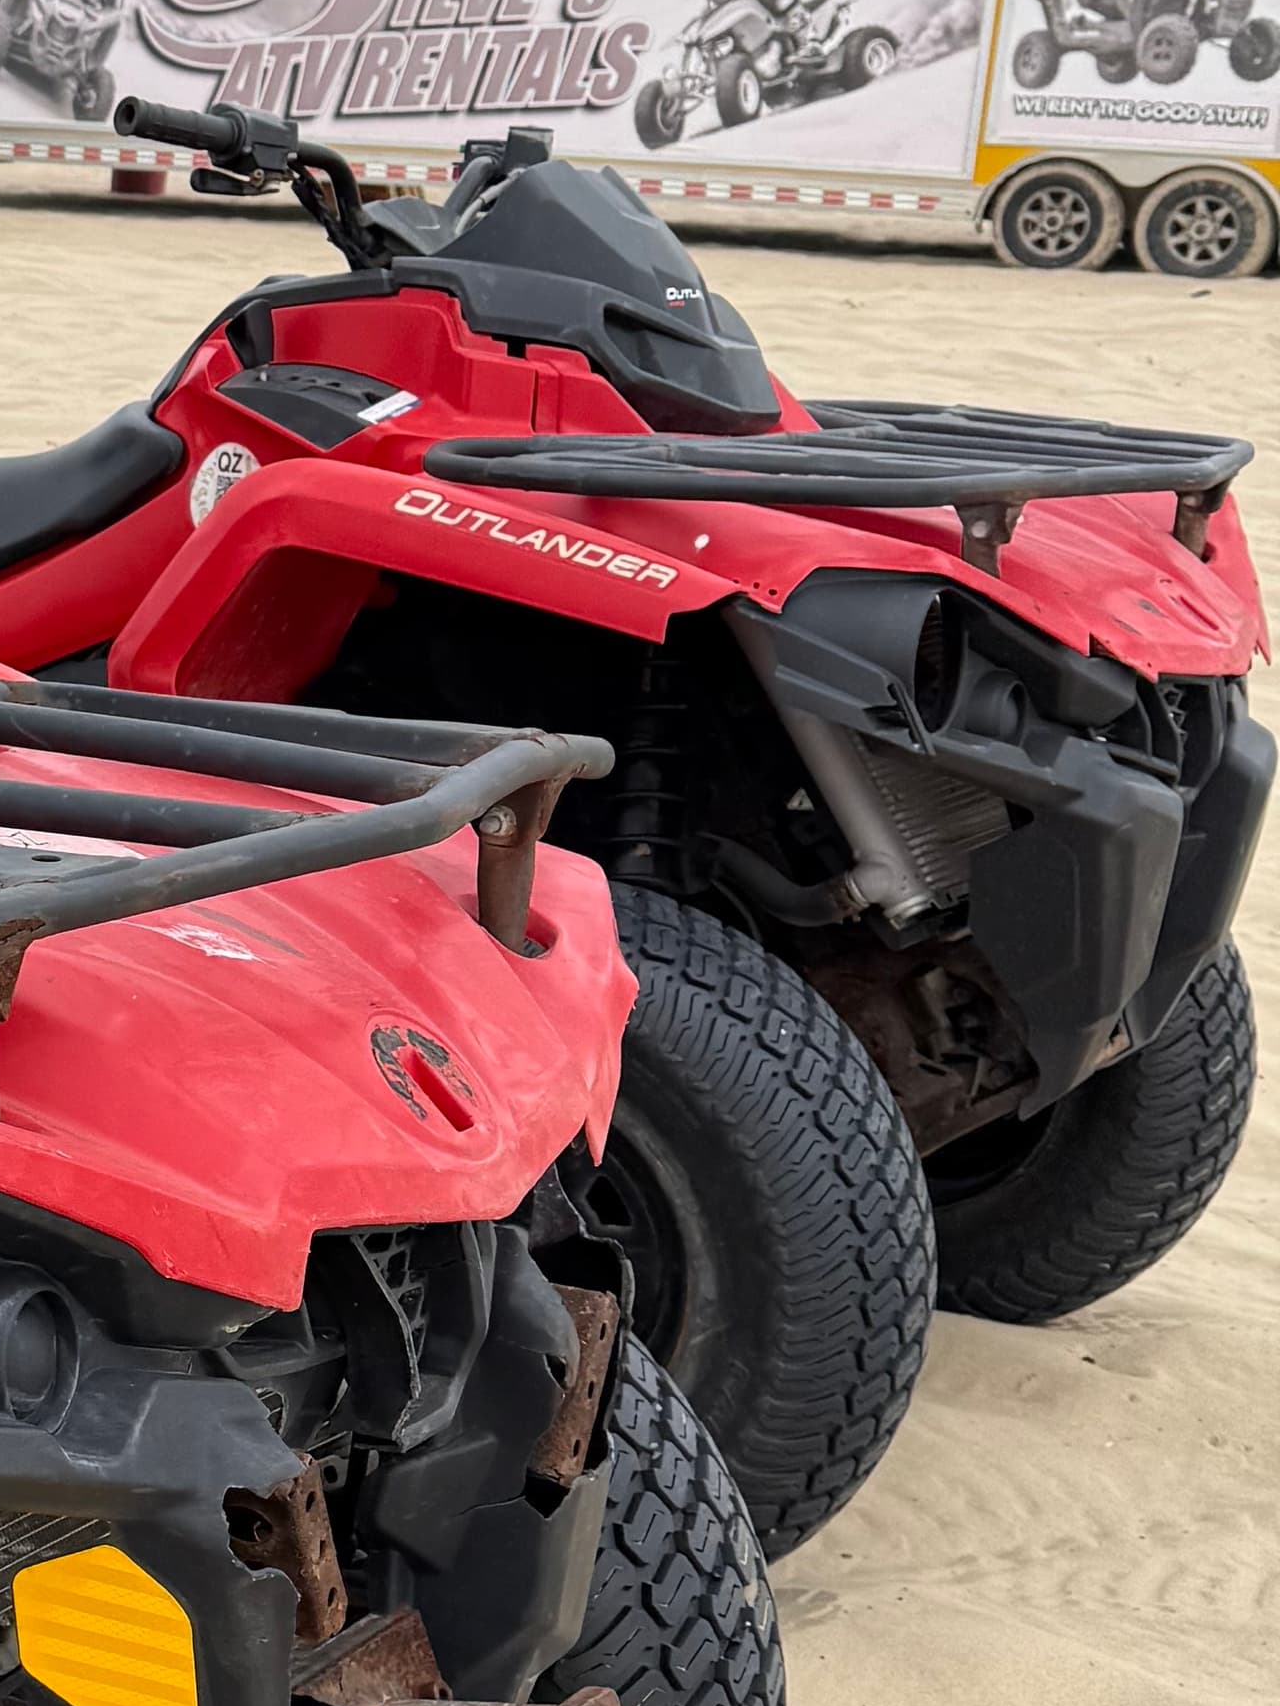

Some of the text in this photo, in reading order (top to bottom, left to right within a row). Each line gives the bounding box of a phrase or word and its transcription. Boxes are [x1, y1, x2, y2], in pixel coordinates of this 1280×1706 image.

[210, 20, 651, 118] ATV RENTALS
[1013, 94, 1045, 116] WE
[1046, 96, 1096, 118] RENT
[1097, 98, 1135, 121] THE
[1135, 99, 1201, 124] GOOD
[218, 451, 243, 473] QZ
[393, 488, 678, 590] OUTLANDER
